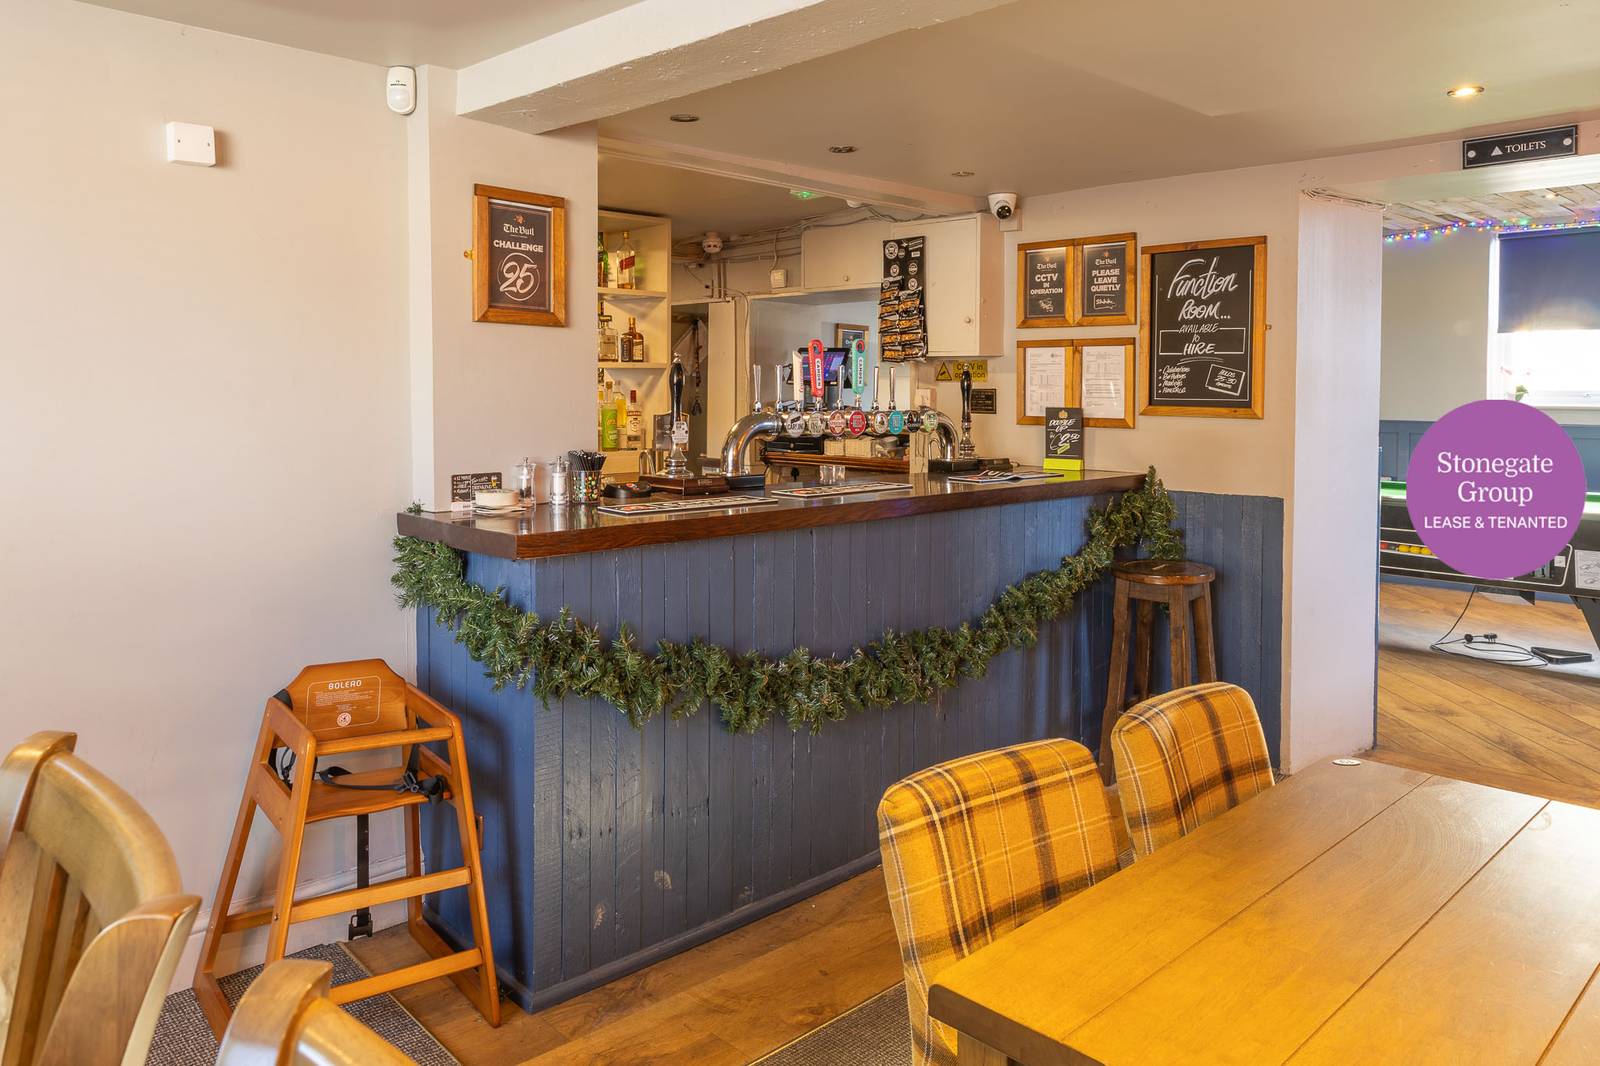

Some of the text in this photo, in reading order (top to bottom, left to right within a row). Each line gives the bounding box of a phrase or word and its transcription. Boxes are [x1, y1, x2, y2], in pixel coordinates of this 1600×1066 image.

[1505, 140, 1547, 153] TOILETS
[503, 223, 535, 236] The Bull
[493, 239, 544, 253] CHALLENGE
[500, 261, 537, 293] 25
[1035, 273, 1058, 282] CCTV
[1092, 268, 1120, 277] PLEASE
[1167, 256, 1238, 300] Function
[1094, 276, 1118, 284] LEAVE
[1030, 287, 1063, 295] OPERATION
[1091, 284, 1121, 292] QUIETLY
[1178, 322, 1219, 333] AVAILABLE
[1183, 343, 1216, 356] HIRE
[328, 680, 362, 690] BOLERO
